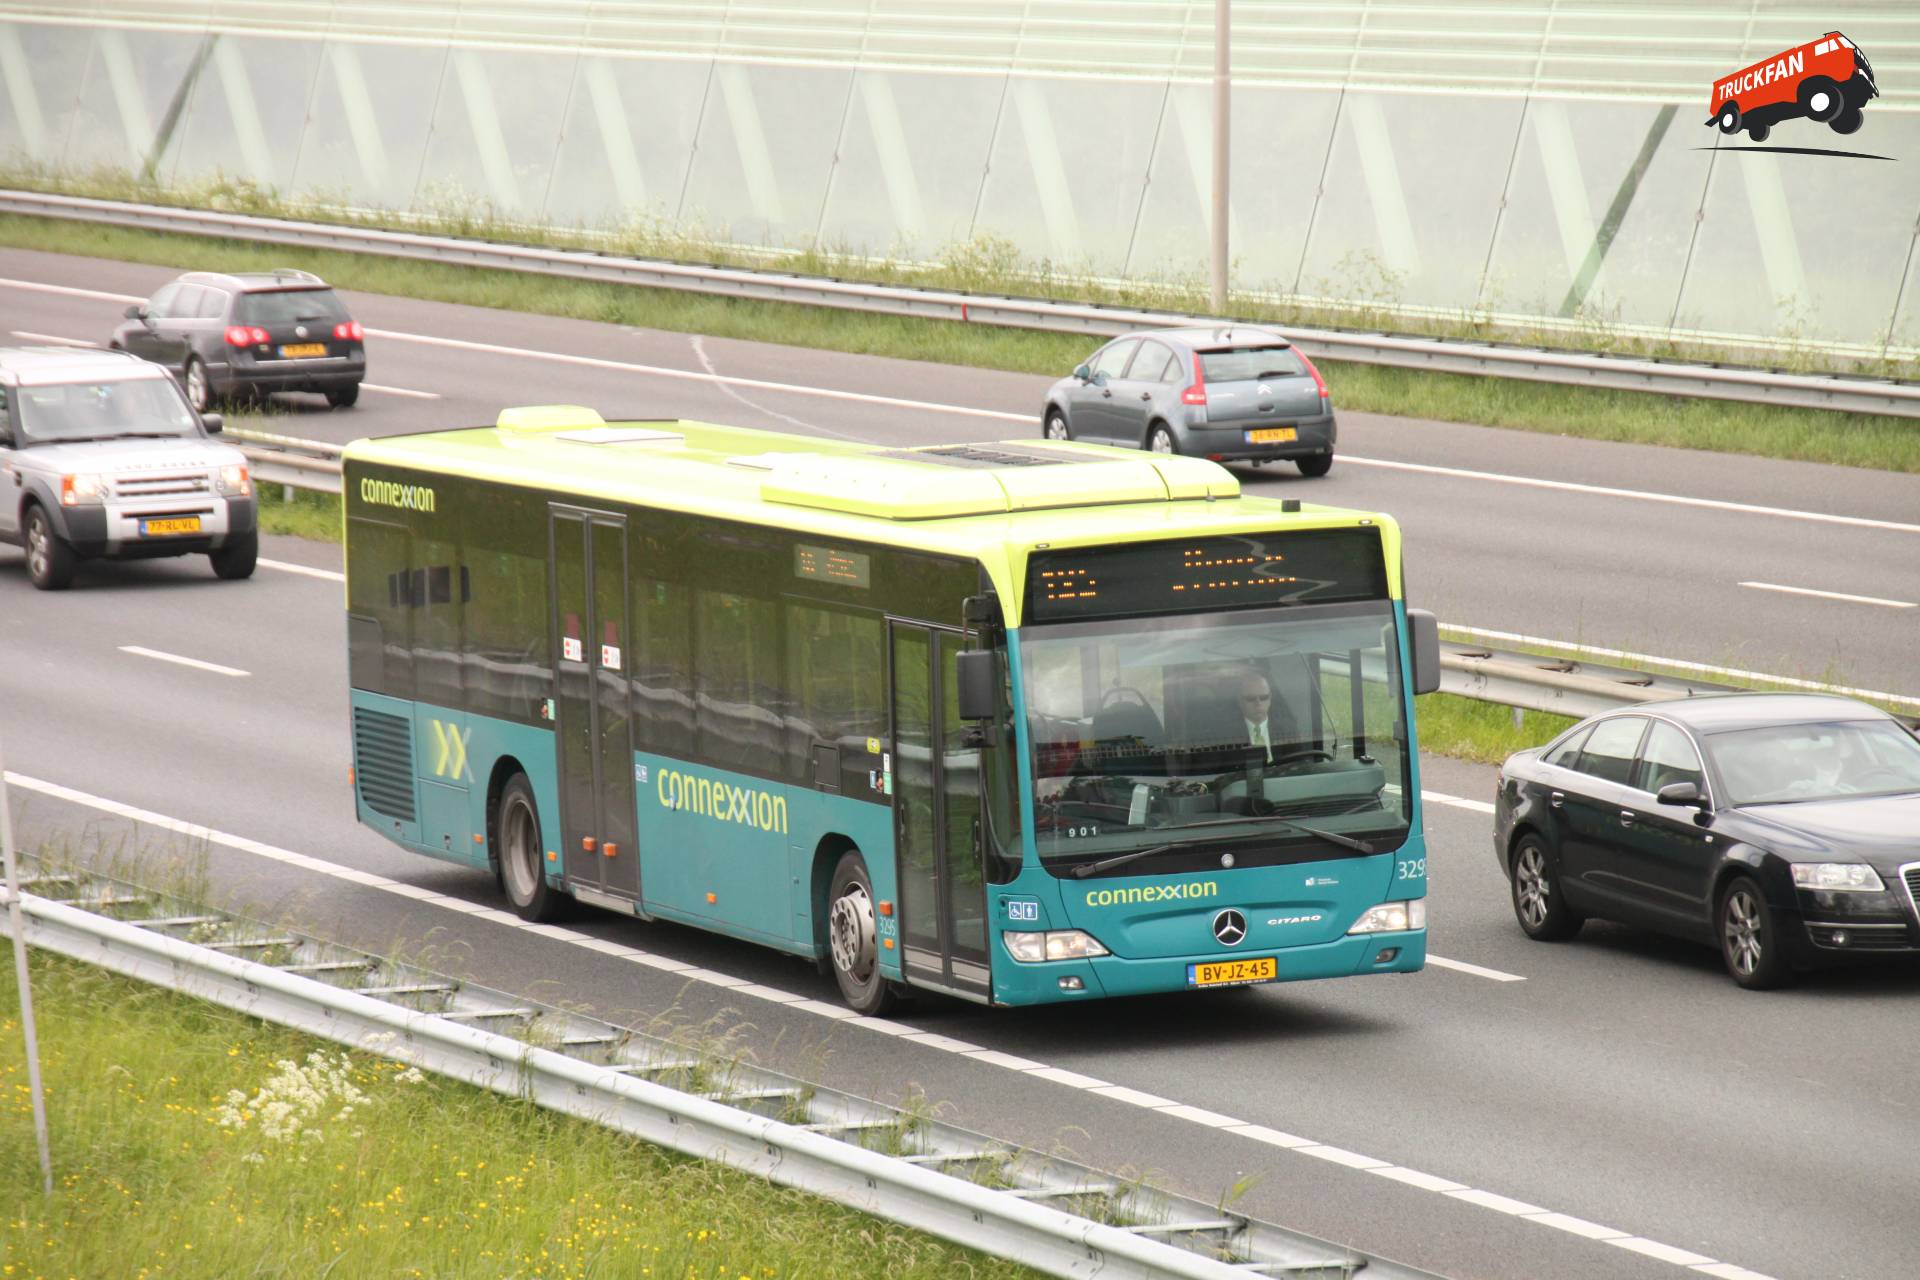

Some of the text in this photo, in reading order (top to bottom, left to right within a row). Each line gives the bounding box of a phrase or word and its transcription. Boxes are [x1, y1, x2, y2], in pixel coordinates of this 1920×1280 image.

[361, 478, 435, 512] connexxion
[658, 768, 788, 834] connexxion
[1068, 826, 1097, 838] 901
[1398, 858, 1426, 880] 329
[1086, 881, 1217, 906] connexxion
[1203, 962, 1270, 981] BV-JZ-45
